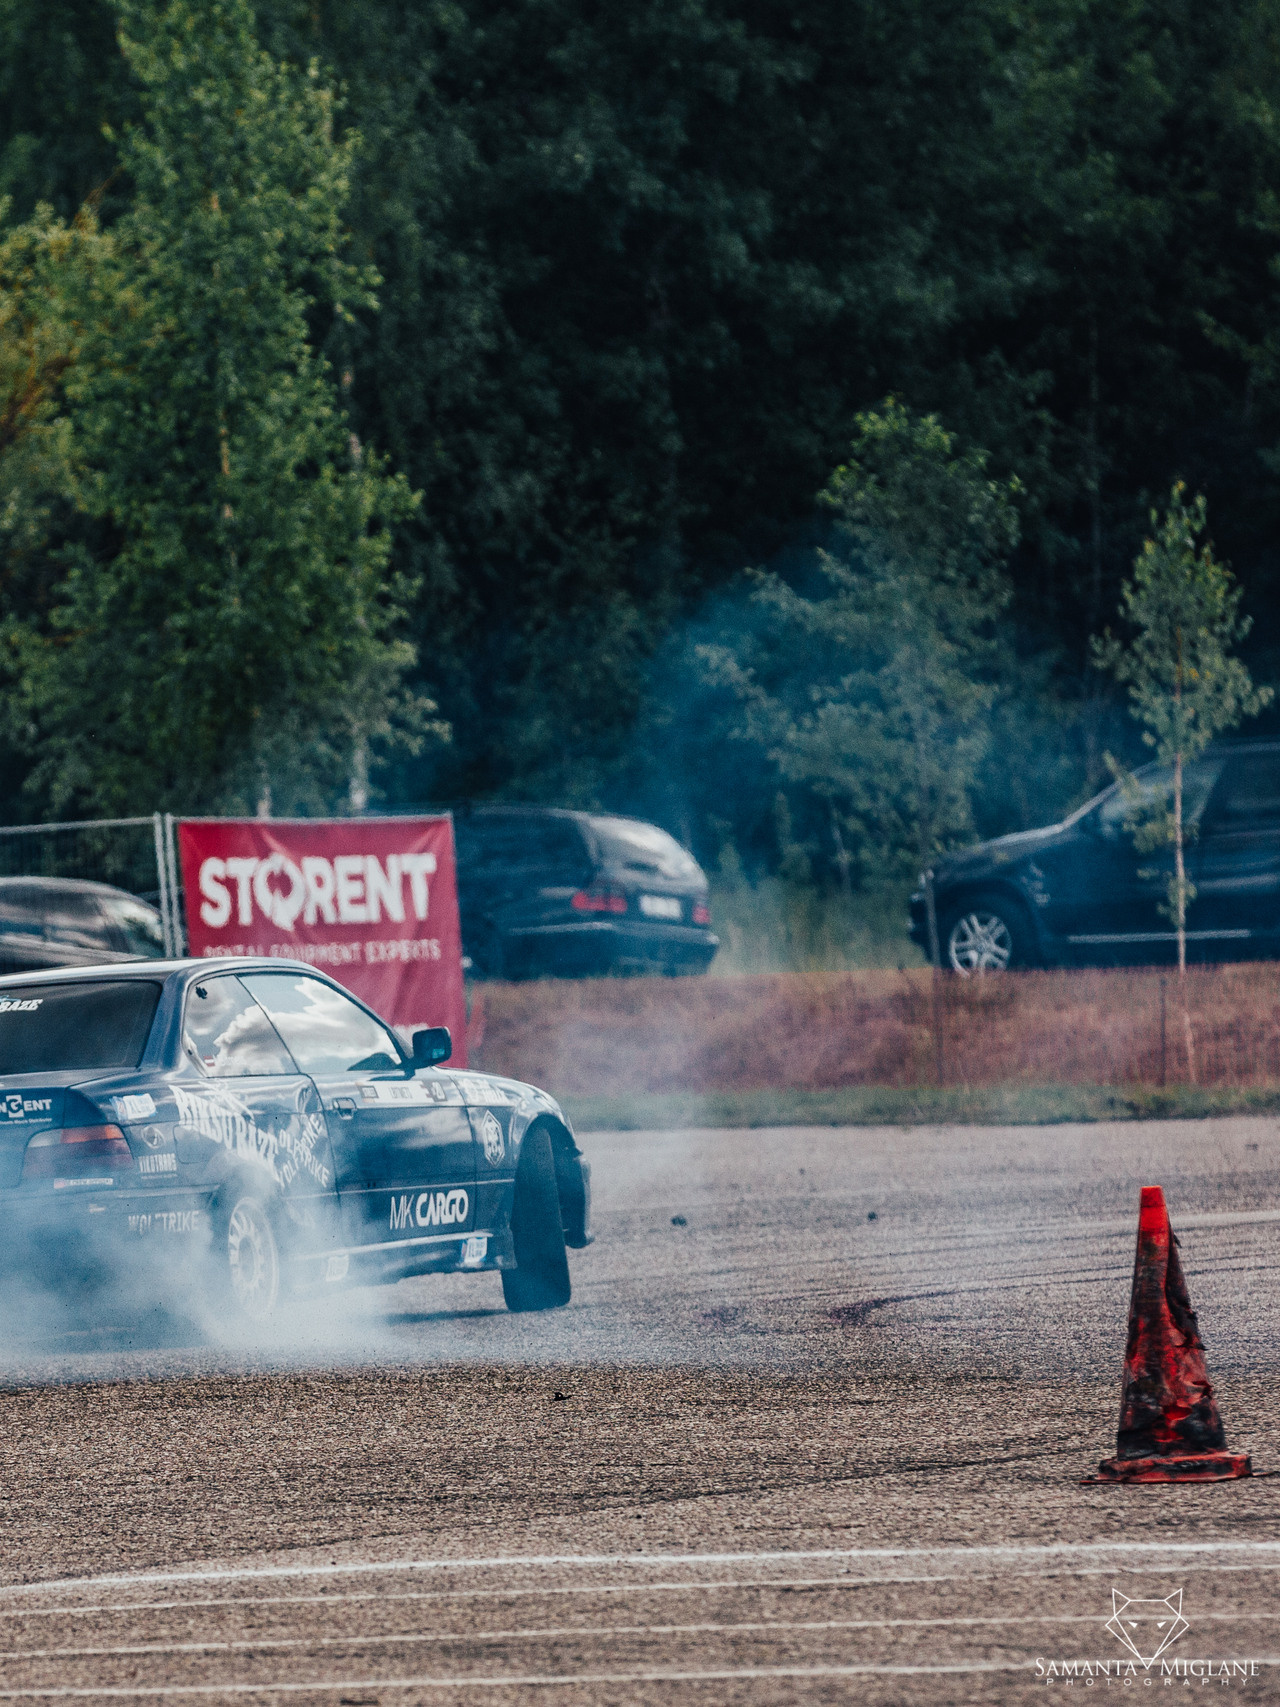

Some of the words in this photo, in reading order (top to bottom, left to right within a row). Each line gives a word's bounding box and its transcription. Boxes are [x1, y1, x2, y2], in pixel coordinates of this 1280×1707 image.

[198, 852, 438, 932] STORENT
[269, 941, 361, 965] EQUIPMENT
[365, 938, 442, 963] EXPERTS
[389, 1194, 415, 1230] MK
[415, 1188, 469, 1227] CARGO
